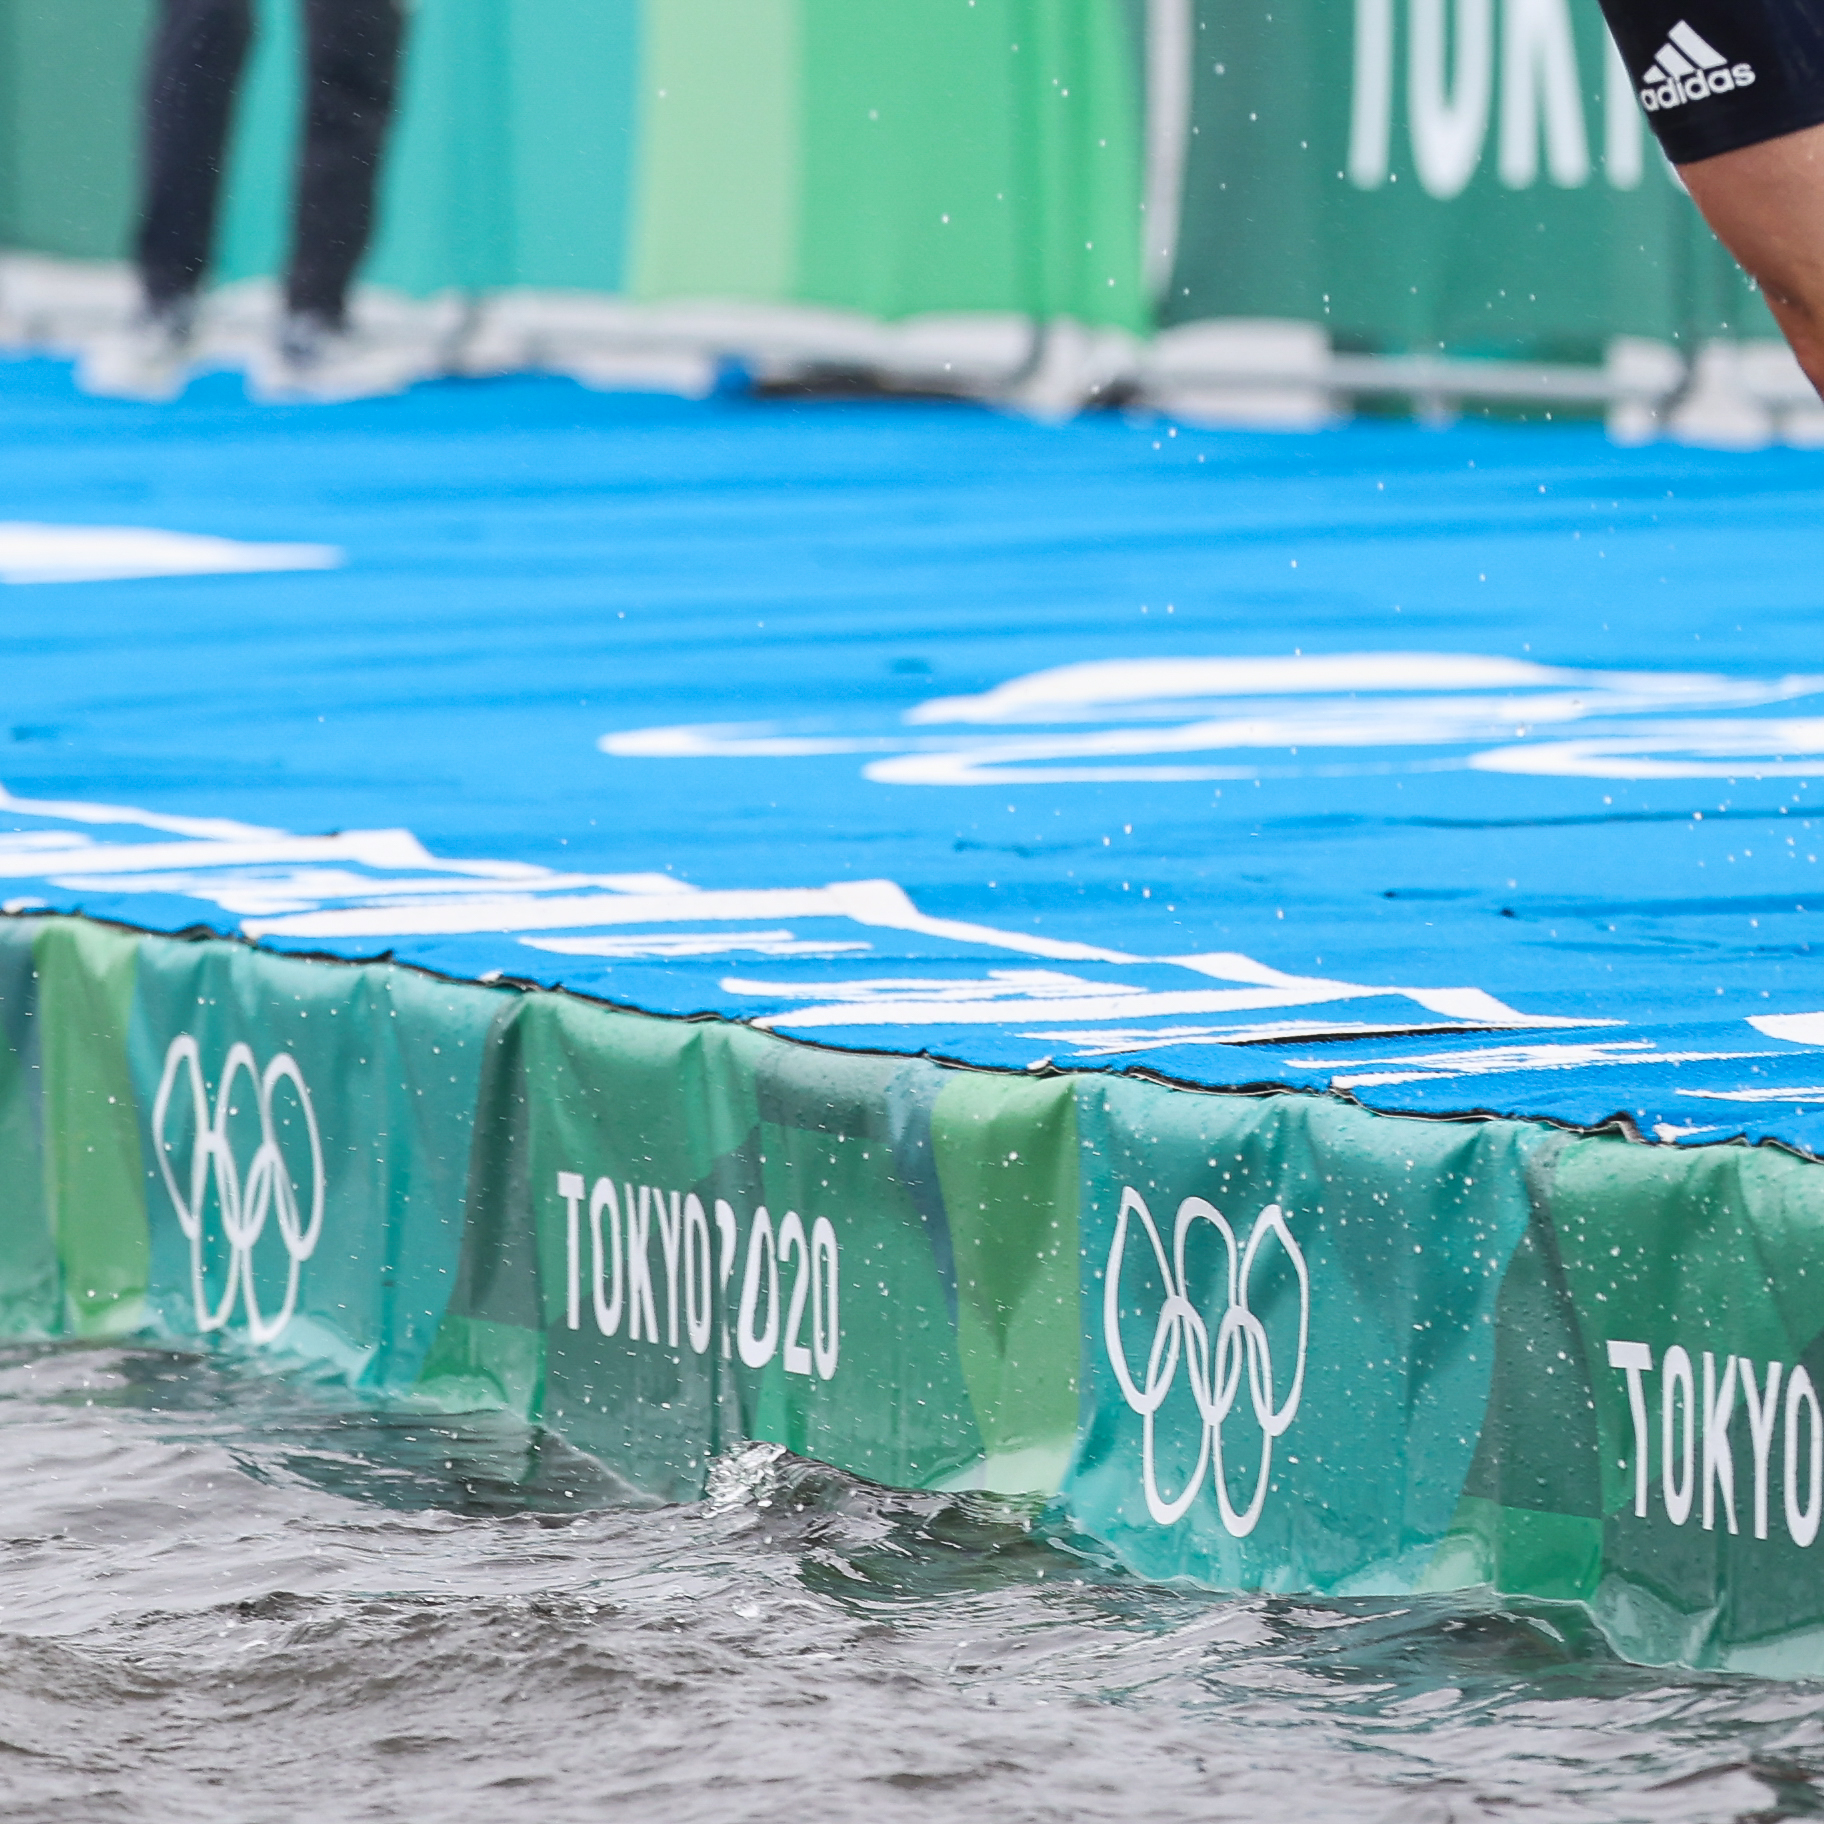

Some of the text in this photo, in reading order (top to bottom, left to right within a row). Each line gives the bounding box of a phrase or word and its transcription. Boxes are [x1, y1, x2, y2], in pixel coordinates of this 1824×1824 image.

[1640, 62, 1756, 112] adidas
[557, 1171, 713, 1355] TOKYO
[1606, 1339, 1824, 1548] TOKYO
